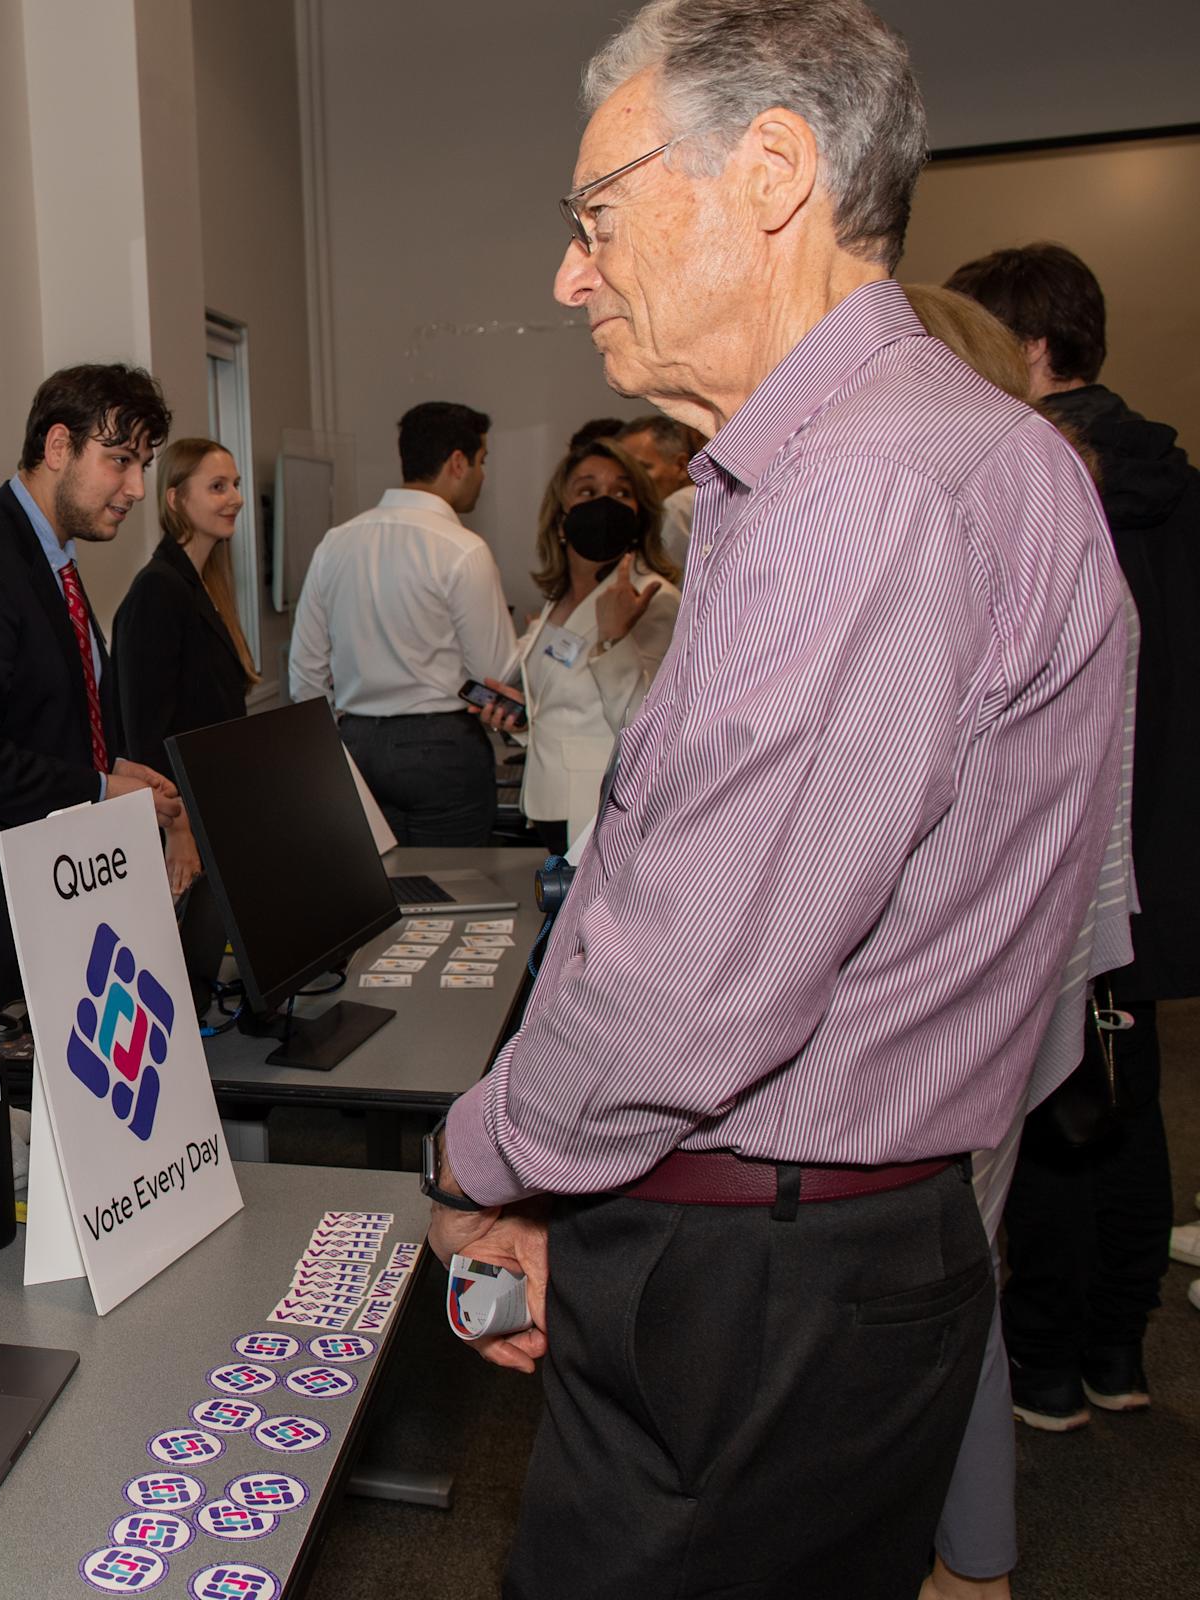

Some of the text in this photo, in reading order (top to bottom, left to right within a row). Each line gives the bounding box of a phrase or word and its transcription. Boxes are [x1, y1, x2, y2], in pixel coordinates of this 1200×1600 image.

[53, 847, 128, 900] Quae
[83, 1133, 221, 1242] Vote Every Day
